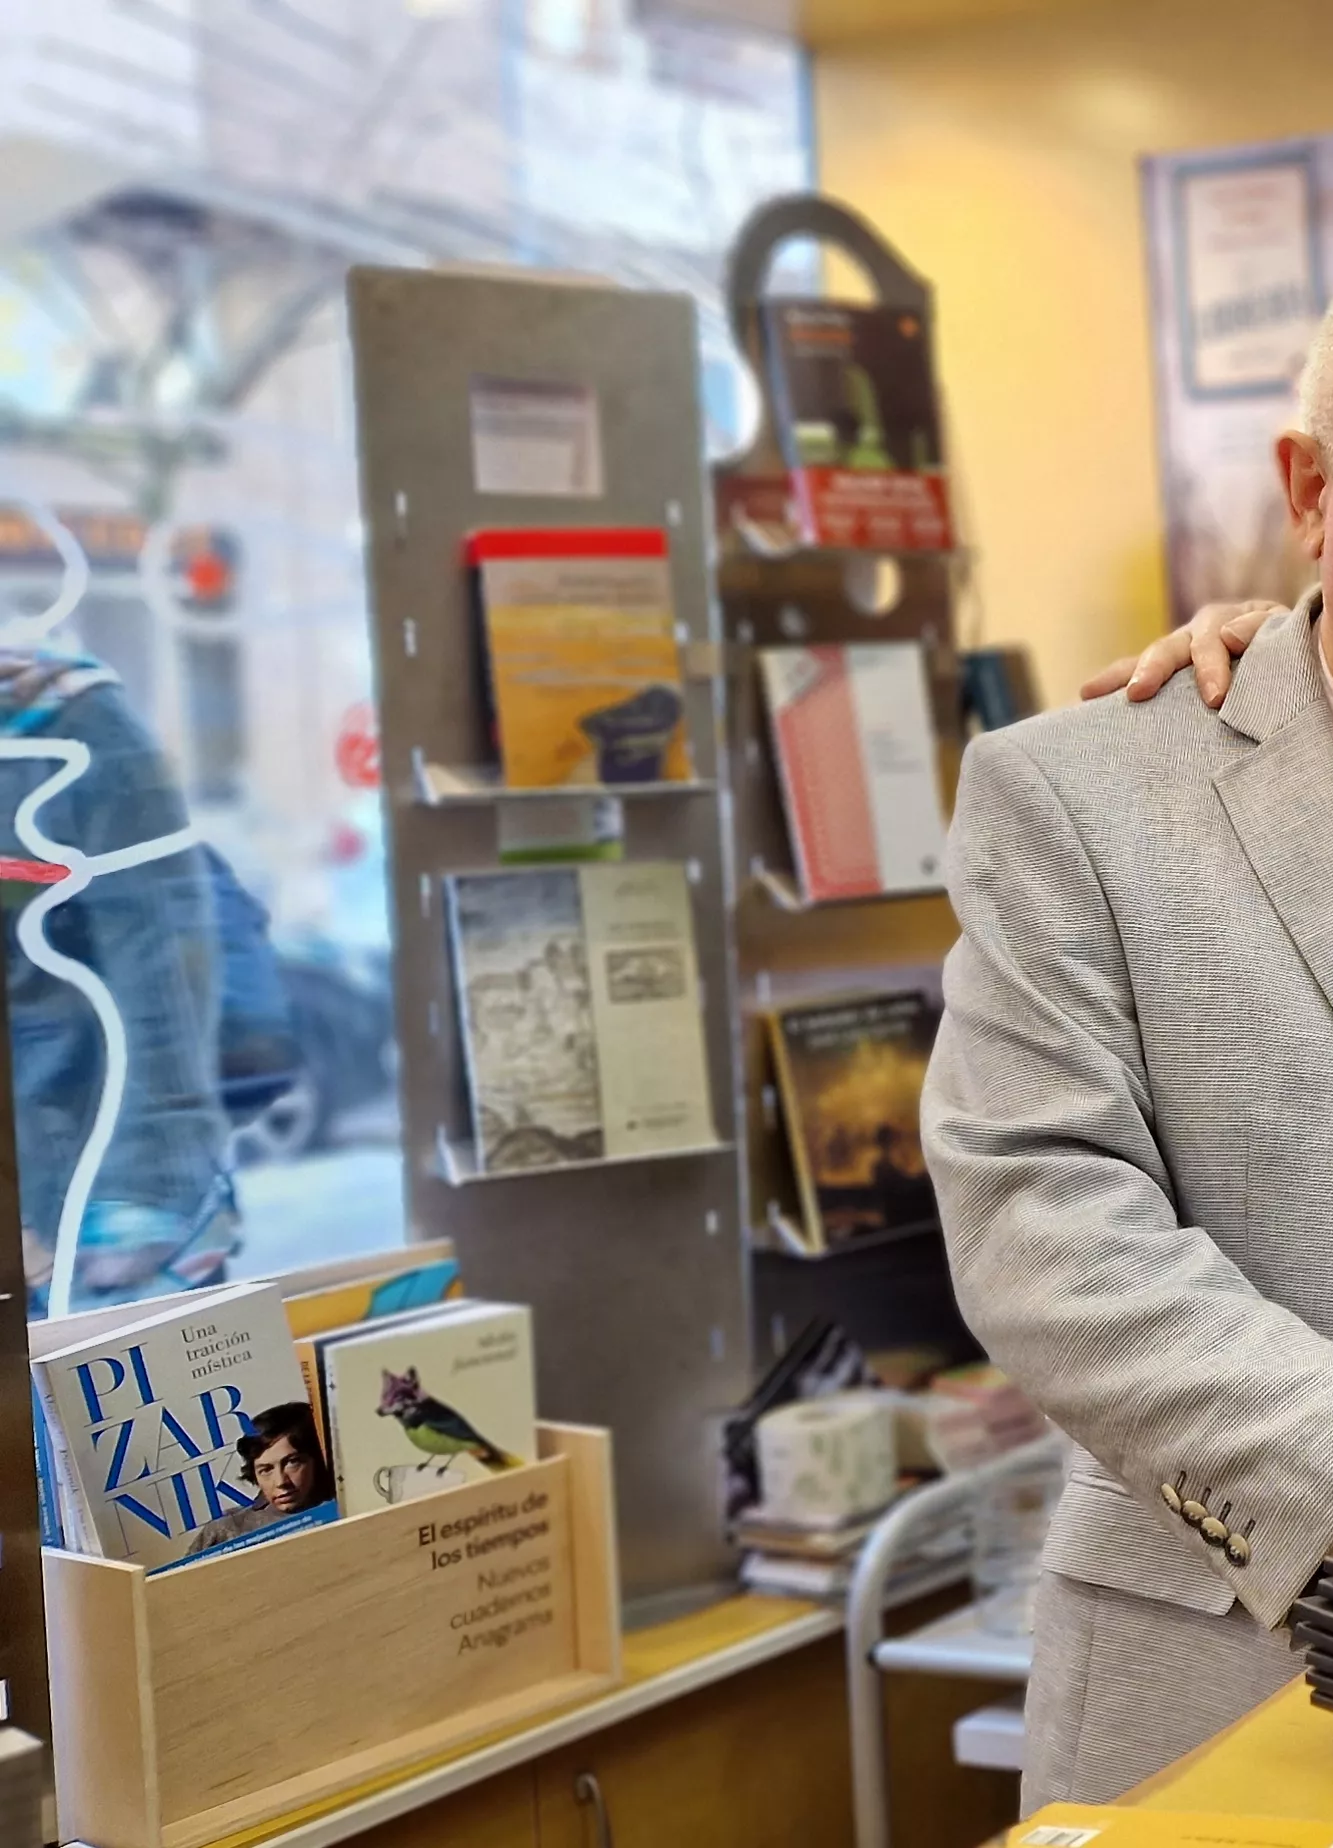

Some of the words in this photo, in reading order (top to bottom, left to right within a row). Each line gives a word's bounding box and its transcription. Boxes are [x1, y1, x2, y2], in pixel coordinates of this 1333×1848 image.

[182, 1325, 217, 1343] Una
[186, 1331, 250, 1362] traición
[67, 1342, 164, 1428] PI
[191, 1351, 252, 1379] mística
[90, 1385, 258, 1493] ZAR
[105, 1451, 257, 1558] NIK
[418, 1523, 437, 1546] El
[521, 1491, 548, 1514] de
[431, 1549, 462, 1570] los
[466, 1519, 549, 1560] tiempos
[477, 1556, 551, 1592] Nuevos
[450, 1583, 552, 1631] cuadernos
[457, 1608, 553, 1656] Anagrama
